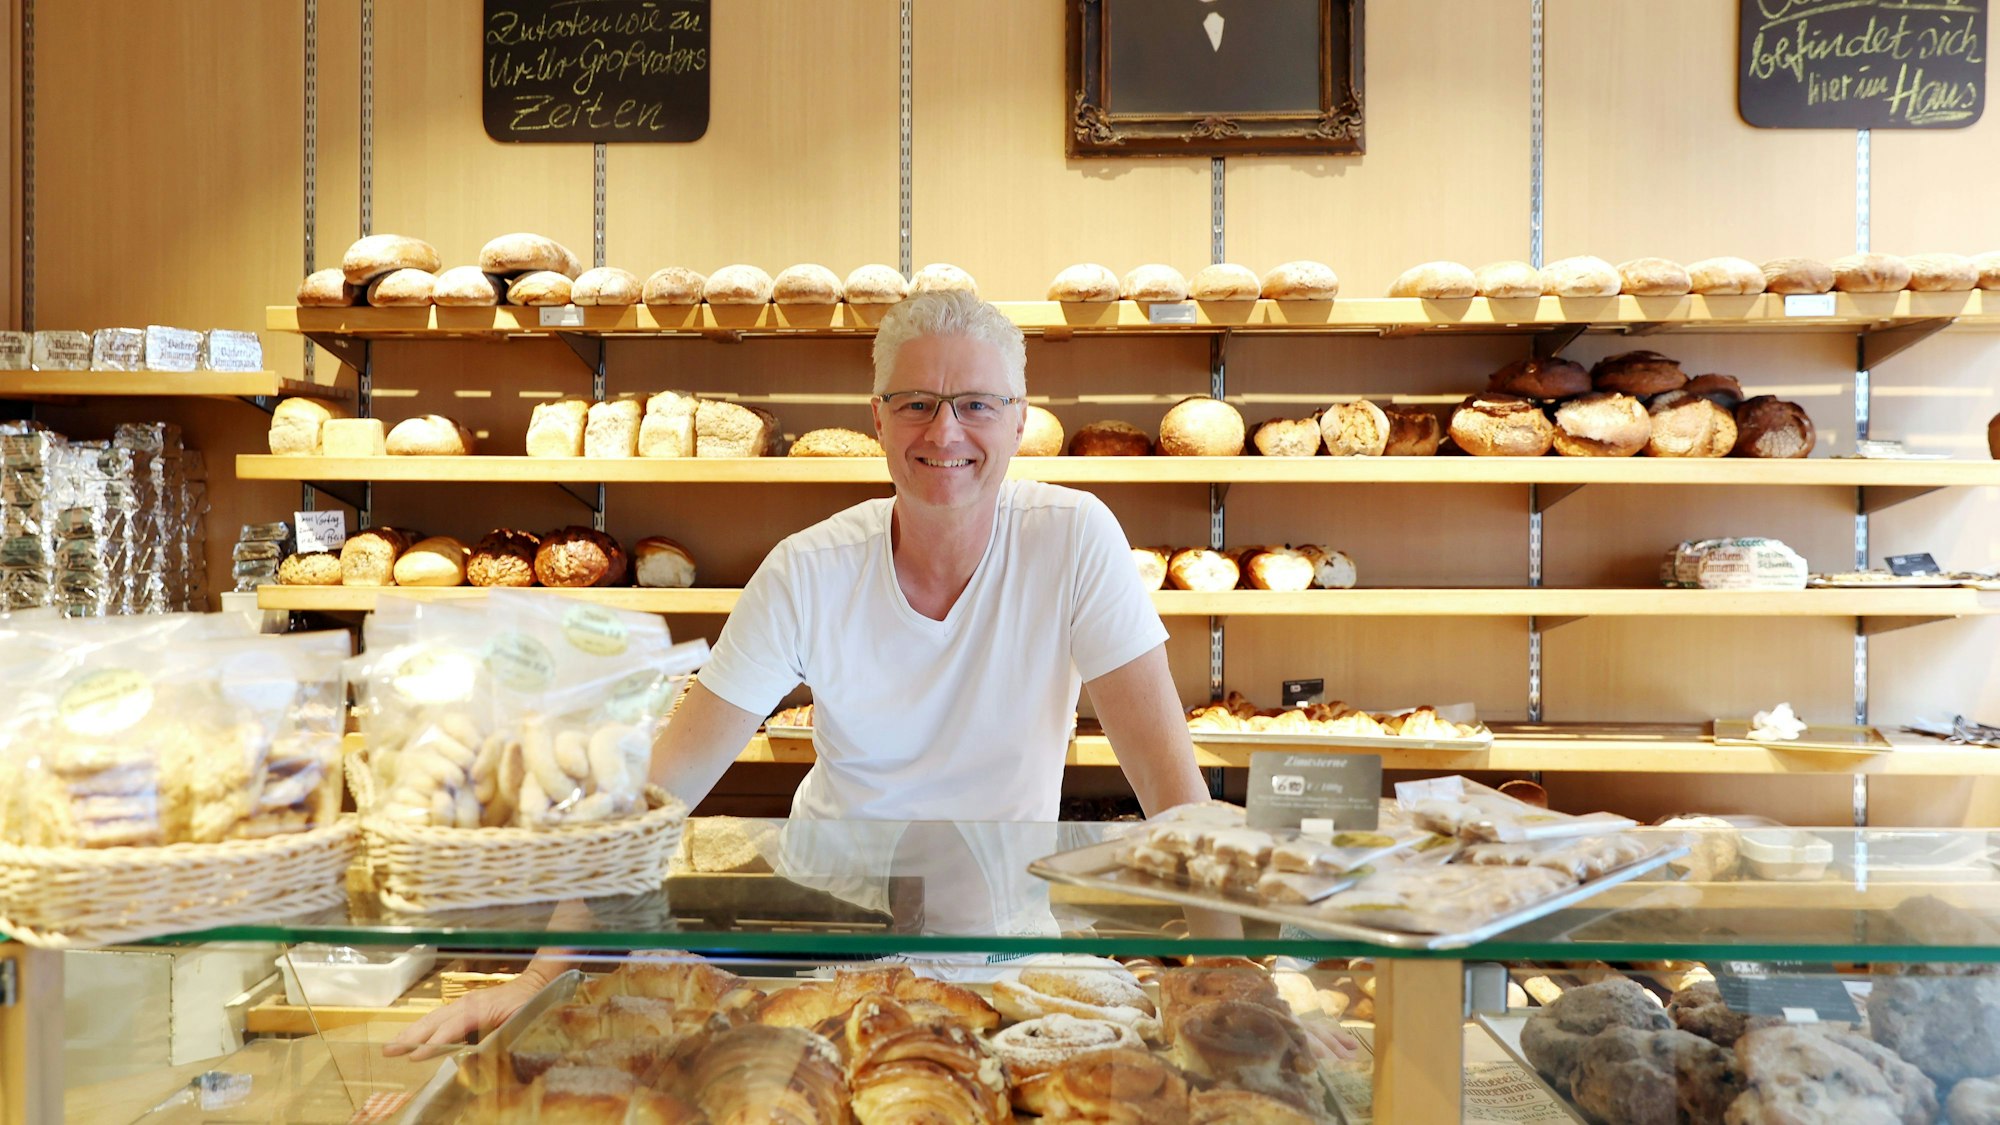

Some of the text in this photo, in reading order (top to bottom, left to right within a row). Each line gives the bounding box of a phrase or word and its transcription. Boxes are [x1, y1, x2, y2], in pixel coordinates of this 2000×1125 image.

[486, 2, 703, 45] Zutaten wie zu
[1748, 14, 1984, 83] befindet sich
[509, 92, 667, 131] Zeiten
[1807, 62, 1977, 122] hier im Haus
